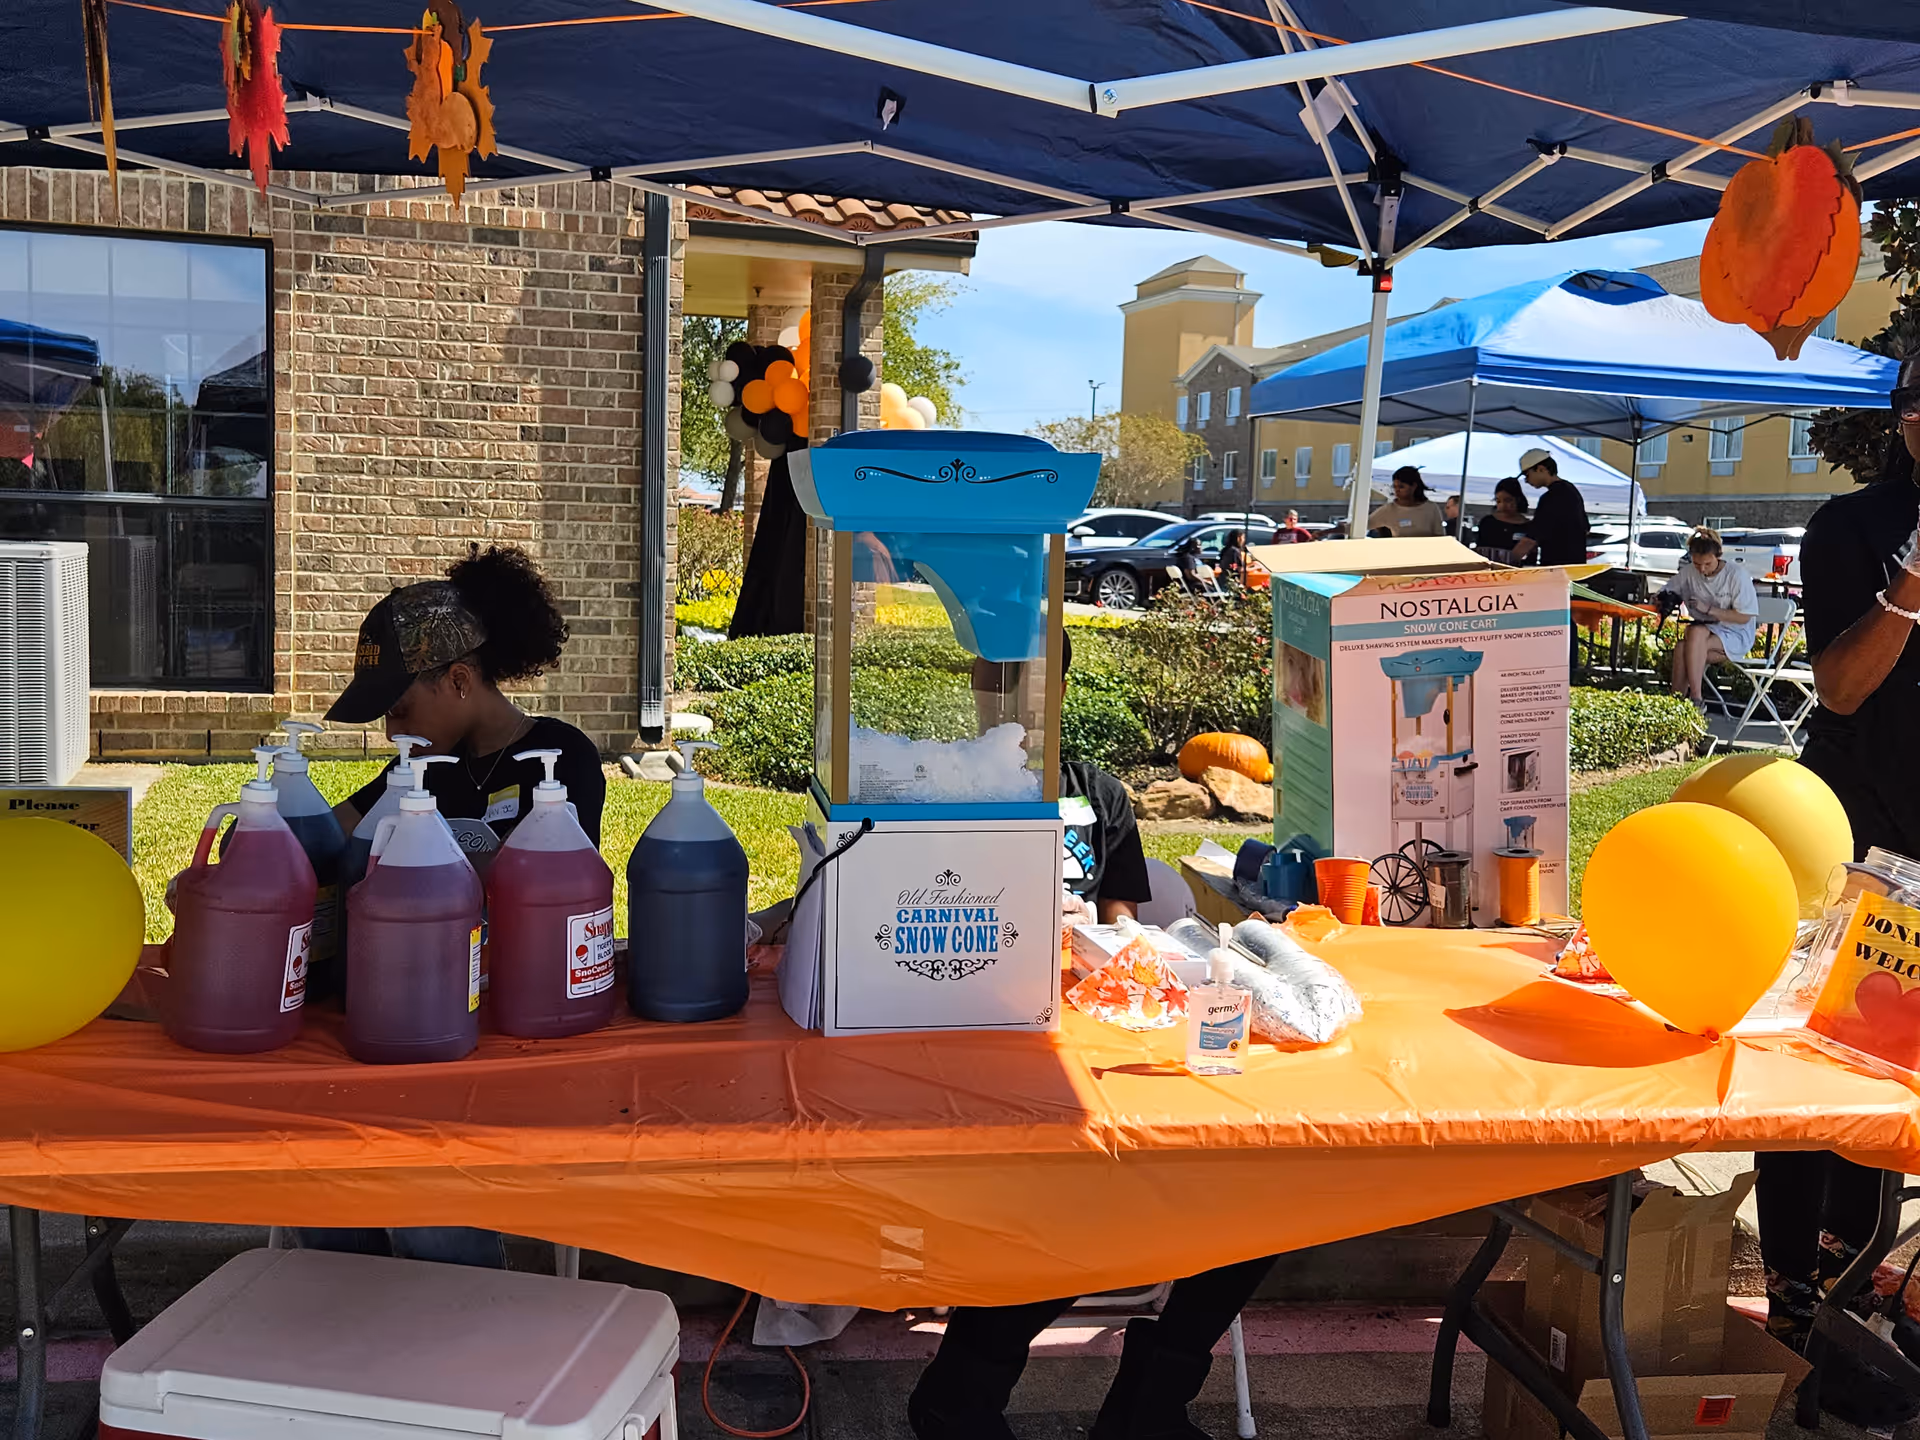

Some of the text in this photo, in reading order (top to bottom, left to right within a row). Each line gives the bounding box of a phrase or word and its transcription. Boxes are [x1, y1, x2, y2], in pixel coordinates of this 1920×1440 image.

[1380, 594, 1519, 620] NOSTALGIA
[1404, 618, 1498, 634] SNOW CONE CART
[1339, 644, 1364, 652] DELUXE
[1365, 642, 1394, 650] SHAVING
[1395, 640, 1421, 648] SYSTEM
[1421, 638, 1443, 646] MAKES
[1444, 635, 1479, 644] PERFECTLY
[1479, 634, 1502, 642] FLUFFY
[1503, 632, 1524, 640] SNOW
[1532, 629, 1564, 638] SECONDS!
[8, 799, 80, 811] Please
[1063, 829, 1095, 873] EEK
[897, 887, 1005, 906] Old Fashioned
[896, 907, 999, 924] CARNIVAL
[894, 925, 999, 955] SNOW CONE
[1862, 912, 1920, 948] DONA
[1855, 940, 1920, 980] WELC
